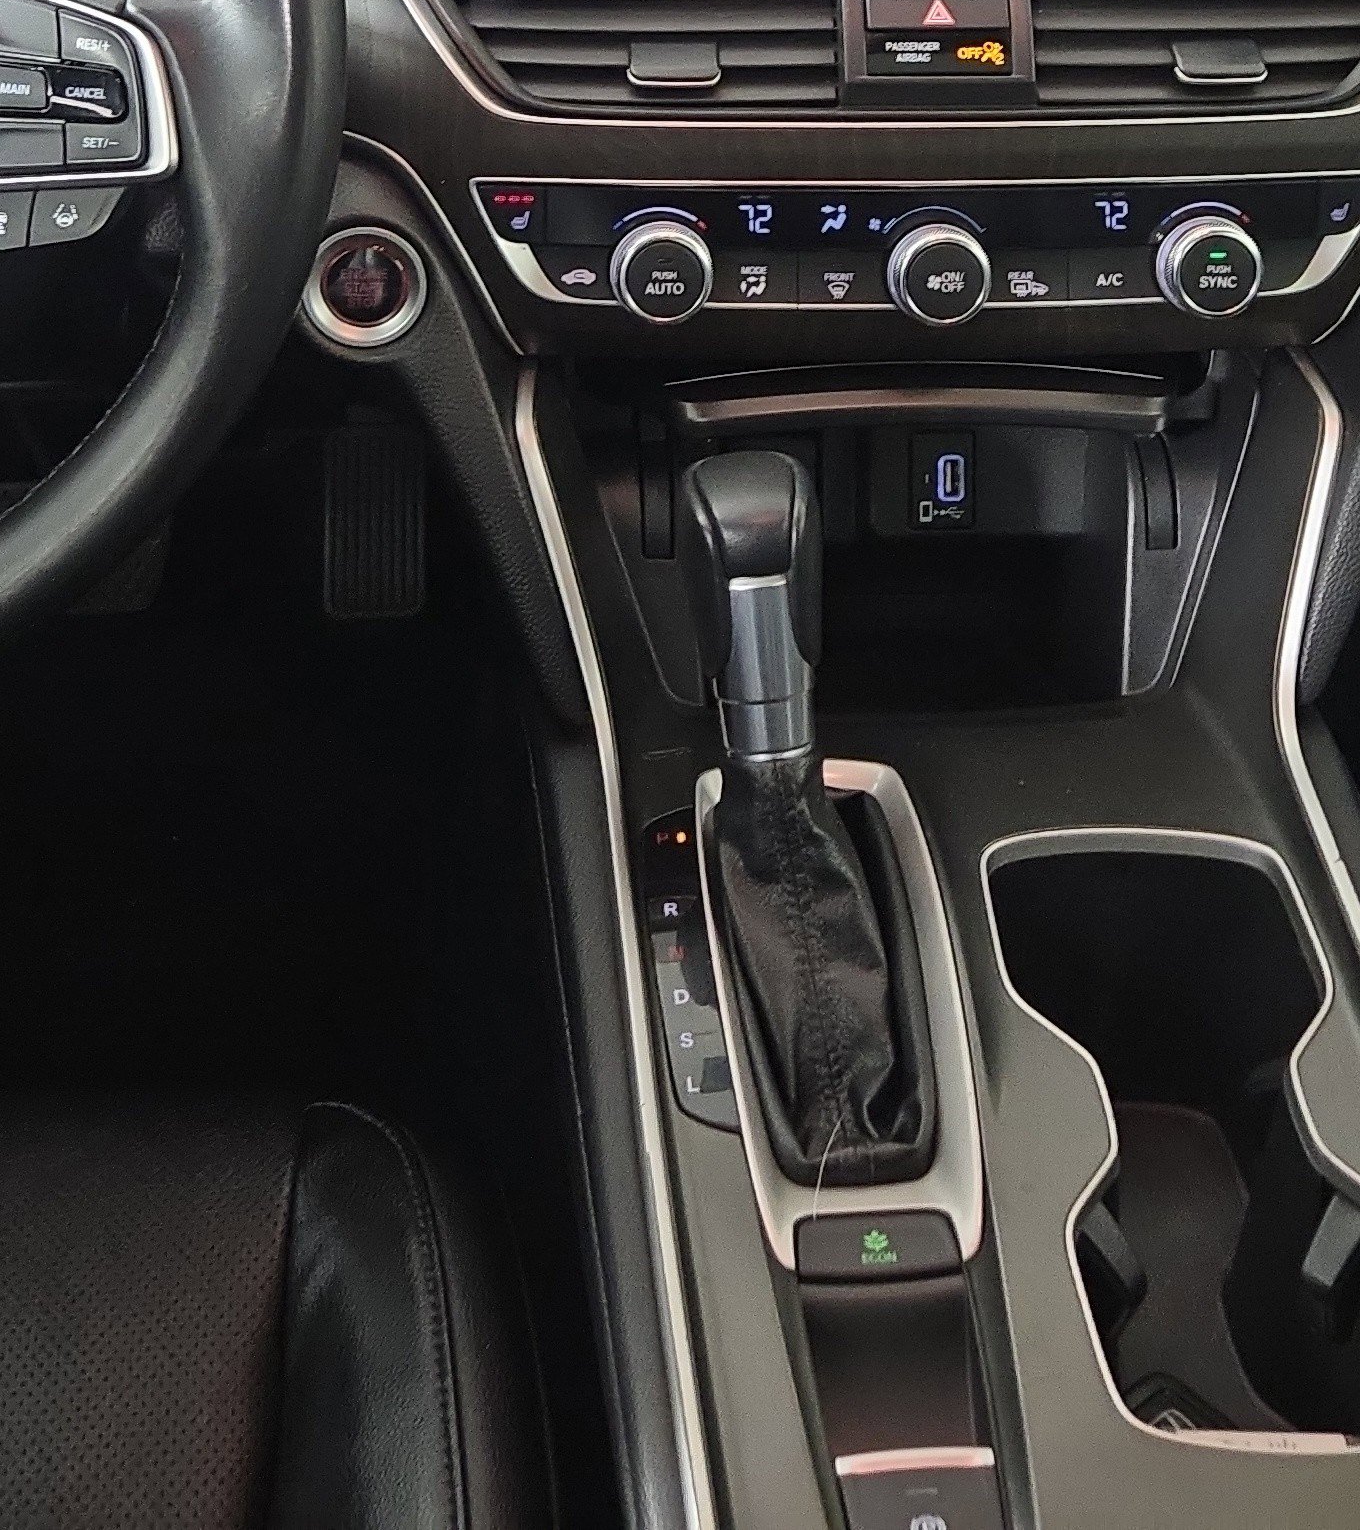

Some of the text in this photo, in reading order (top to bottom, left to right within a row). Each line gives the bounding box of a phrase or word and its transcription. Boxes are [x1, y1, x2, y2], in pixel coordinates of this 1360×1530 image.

[885, 41, 940, 52] PASSENGER
[957, 46, 984, 60] OFF
[896, 53, 932, 63] AIRBAG
[0, 82, 31, 96] MAIN
[65, 86, 107, 100] CANCEL
[738, 204, 772, 234] 72
[1094, 200, 1129, 231] 72
[651, 270, 678, 280] PUSH
[740, 266, 768, 275] MODE
[823, 273, 855, 282] FRONT
[941, 272, 965, 282] ON/
[1007, 271, 1034, 280] REAR
[1096, 272, 1124, 288] A/C
[1199, 275, 1237, 290] SYNC
[644, 282, 684, 296] AUTO
[941, 283, 965, 293] OFF
[663, 902, 679, 917] R
[673, 988, 690, 1005] D
[679, 1032, 695, 1048] S
[686, 1076, 701, 1093] L
